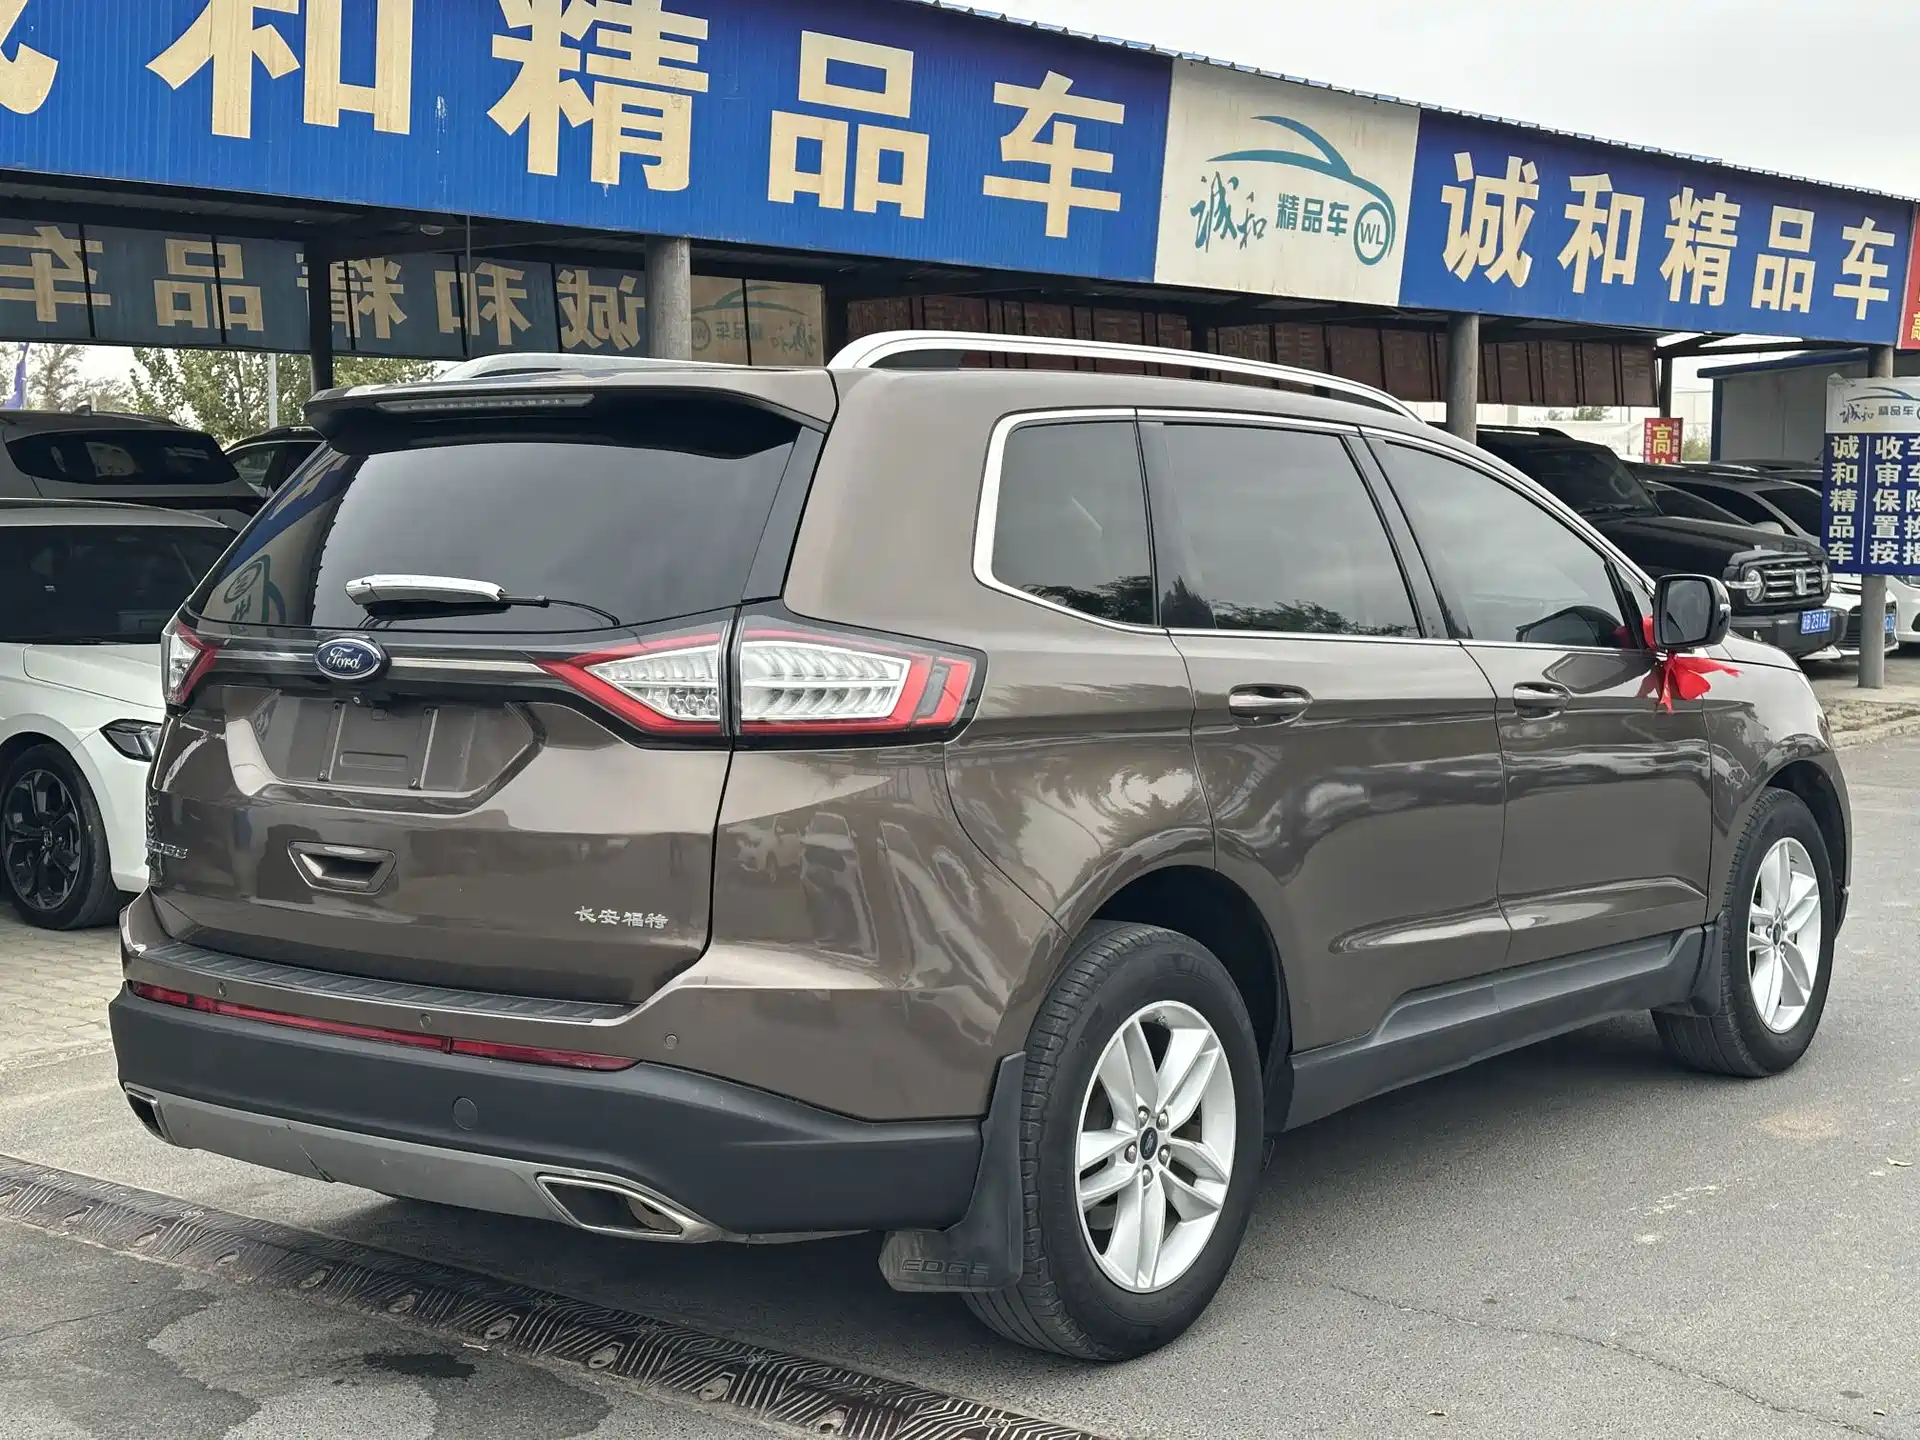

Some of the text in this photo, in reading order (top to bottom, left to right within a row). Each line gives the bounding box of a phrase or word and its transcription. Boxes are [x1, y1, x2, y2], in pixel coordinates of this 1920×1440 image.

[0, 0, 1126, 238] 和精品车
[1275, 192, 1350, 237] 精品车
[1359, 222, 1384, 246] WL
[1440, 151, 1895, 321] 诚和精品车
[1827, 435, 1860, 565] 诚和精品车
[326, 646, 363, 670] Ford
[573, 905, 669, 929] 长安福特
[901, 1259, 990, 1279] EDGE
